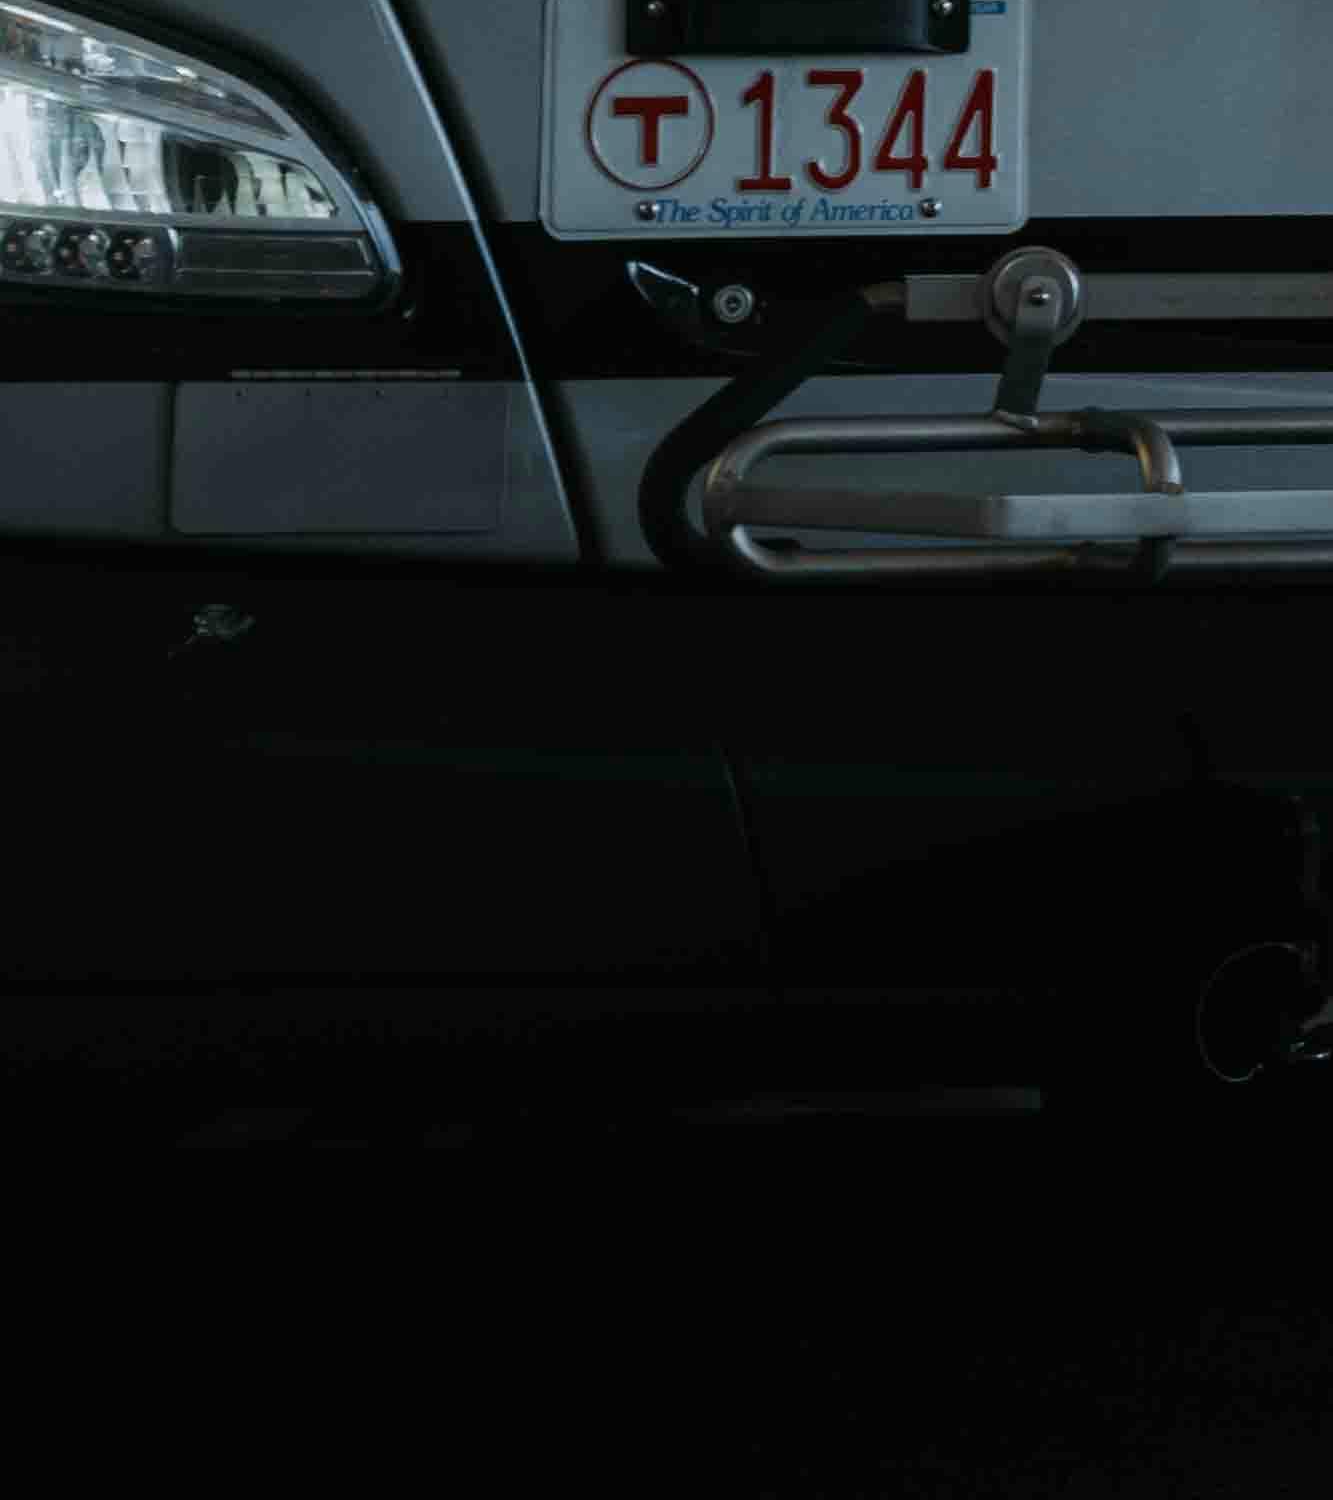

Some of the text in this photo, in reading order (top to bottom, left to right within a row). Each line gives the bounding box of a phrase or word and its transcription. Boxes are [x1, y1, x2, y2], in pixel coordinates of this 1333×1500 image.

[612, 67, 999, 193] T 1344
[656, 197, 914, 228] The Spirit of America
